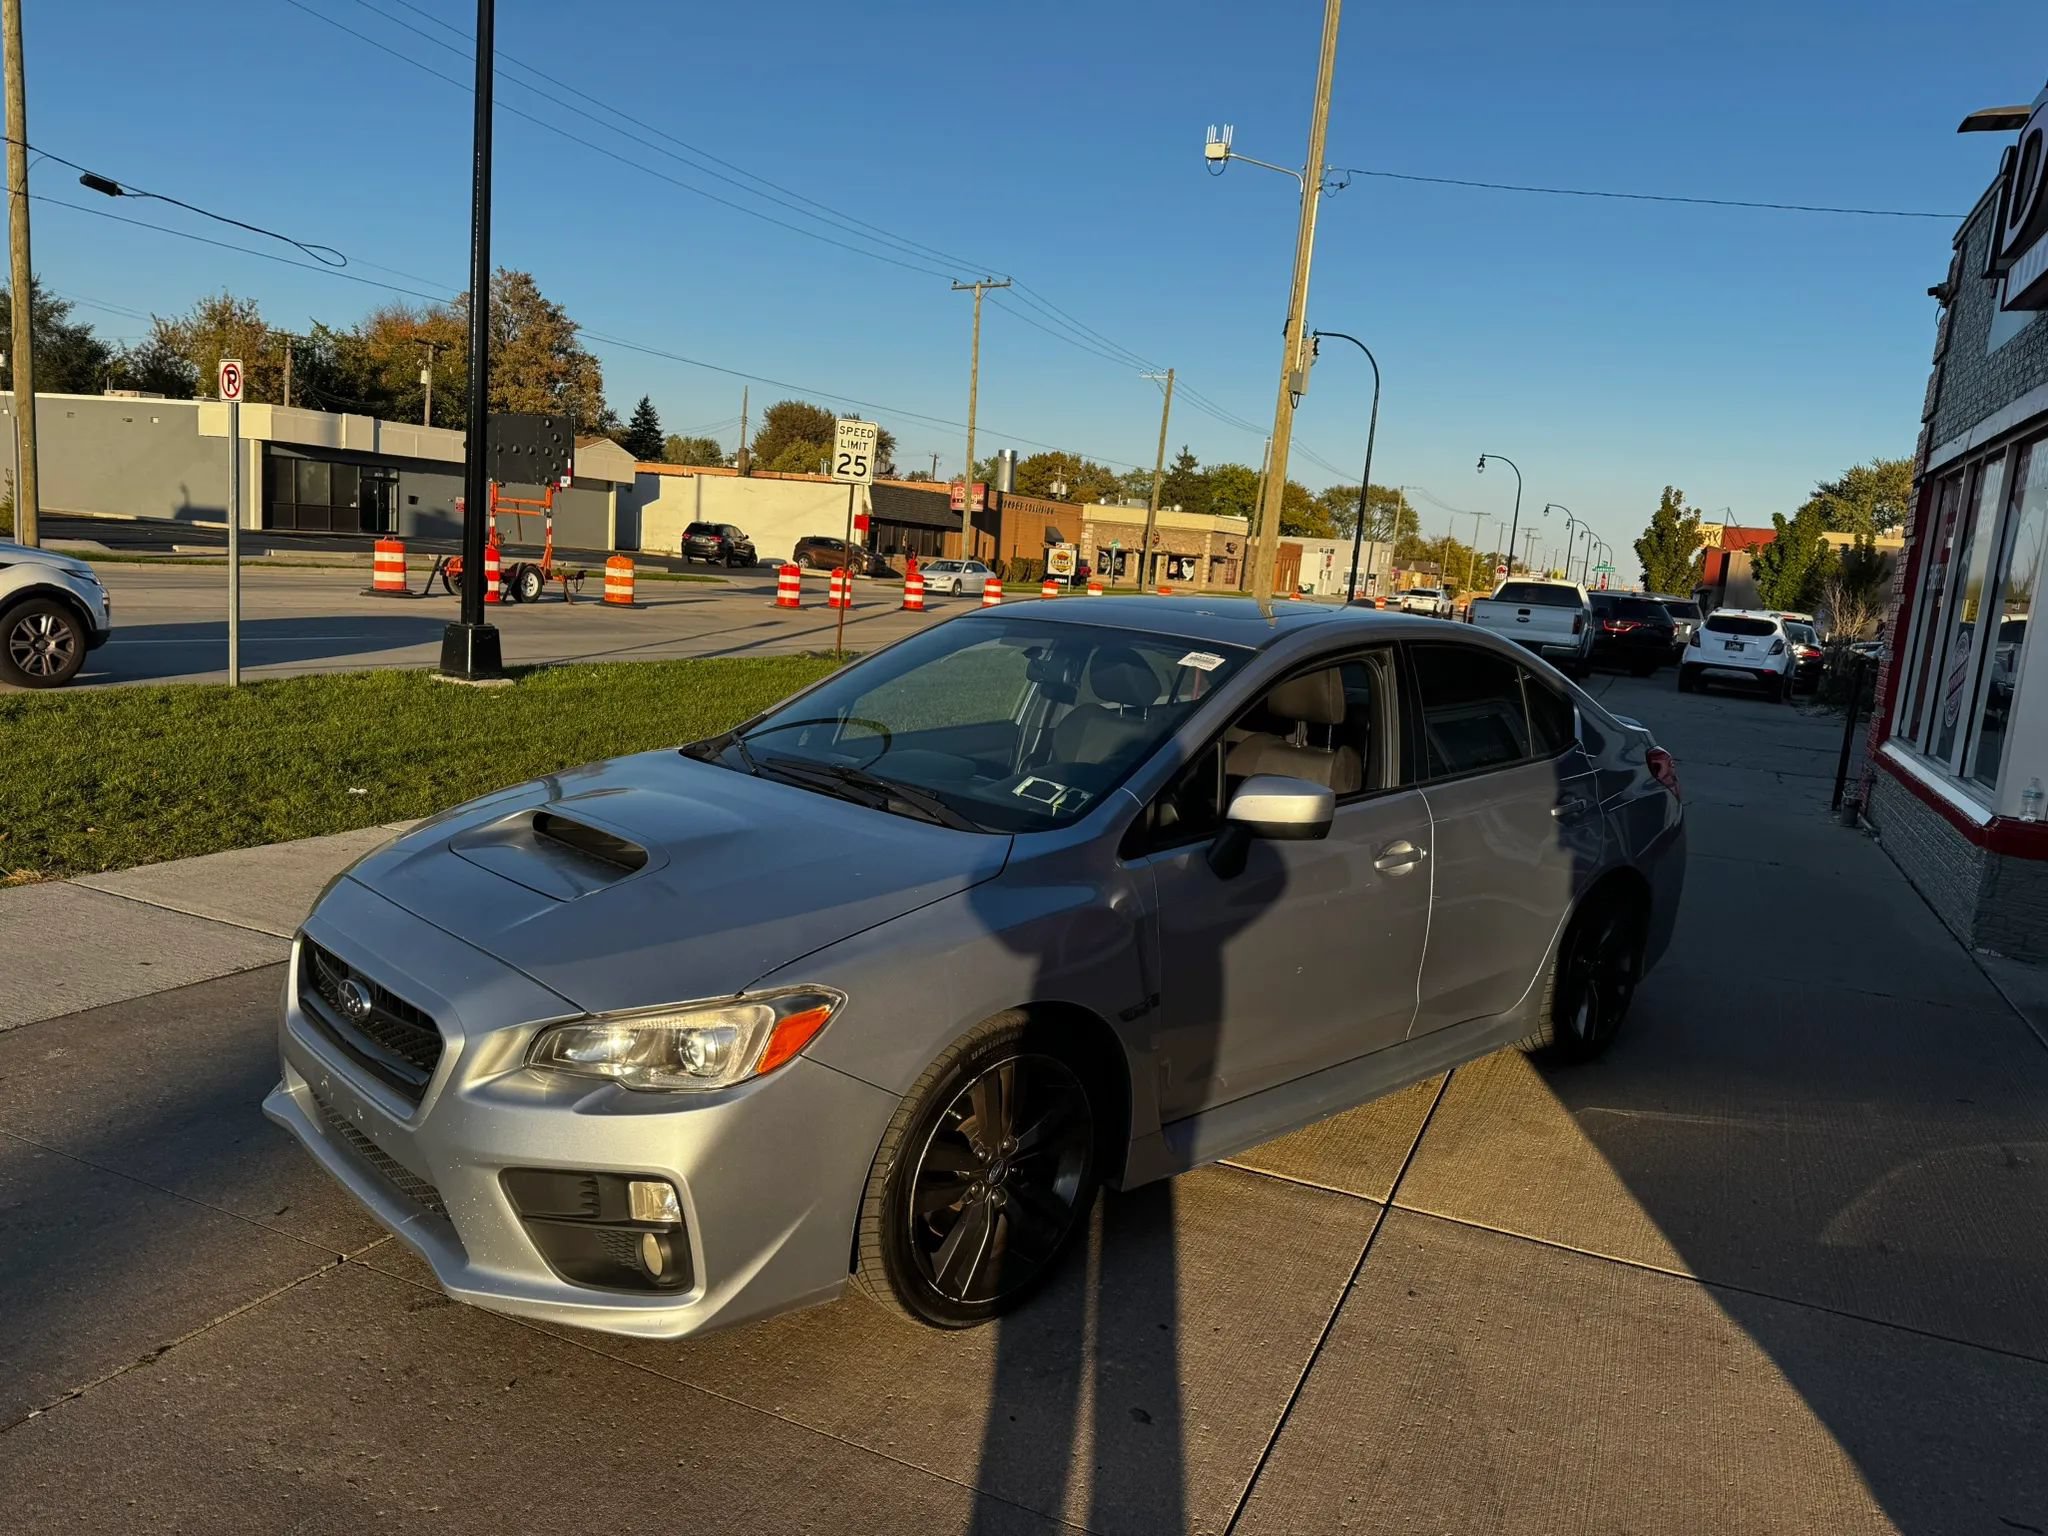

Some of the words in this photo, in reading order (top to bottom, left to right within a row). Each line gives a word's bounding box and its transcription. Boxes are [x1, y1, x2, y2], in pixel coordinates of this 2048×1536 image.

[227, 369, 238, 392] P
[839, 425, 874, 439] SPEED
[840, 439, 869, 451] LIMIT
[836, 453, 867, 477] 25
